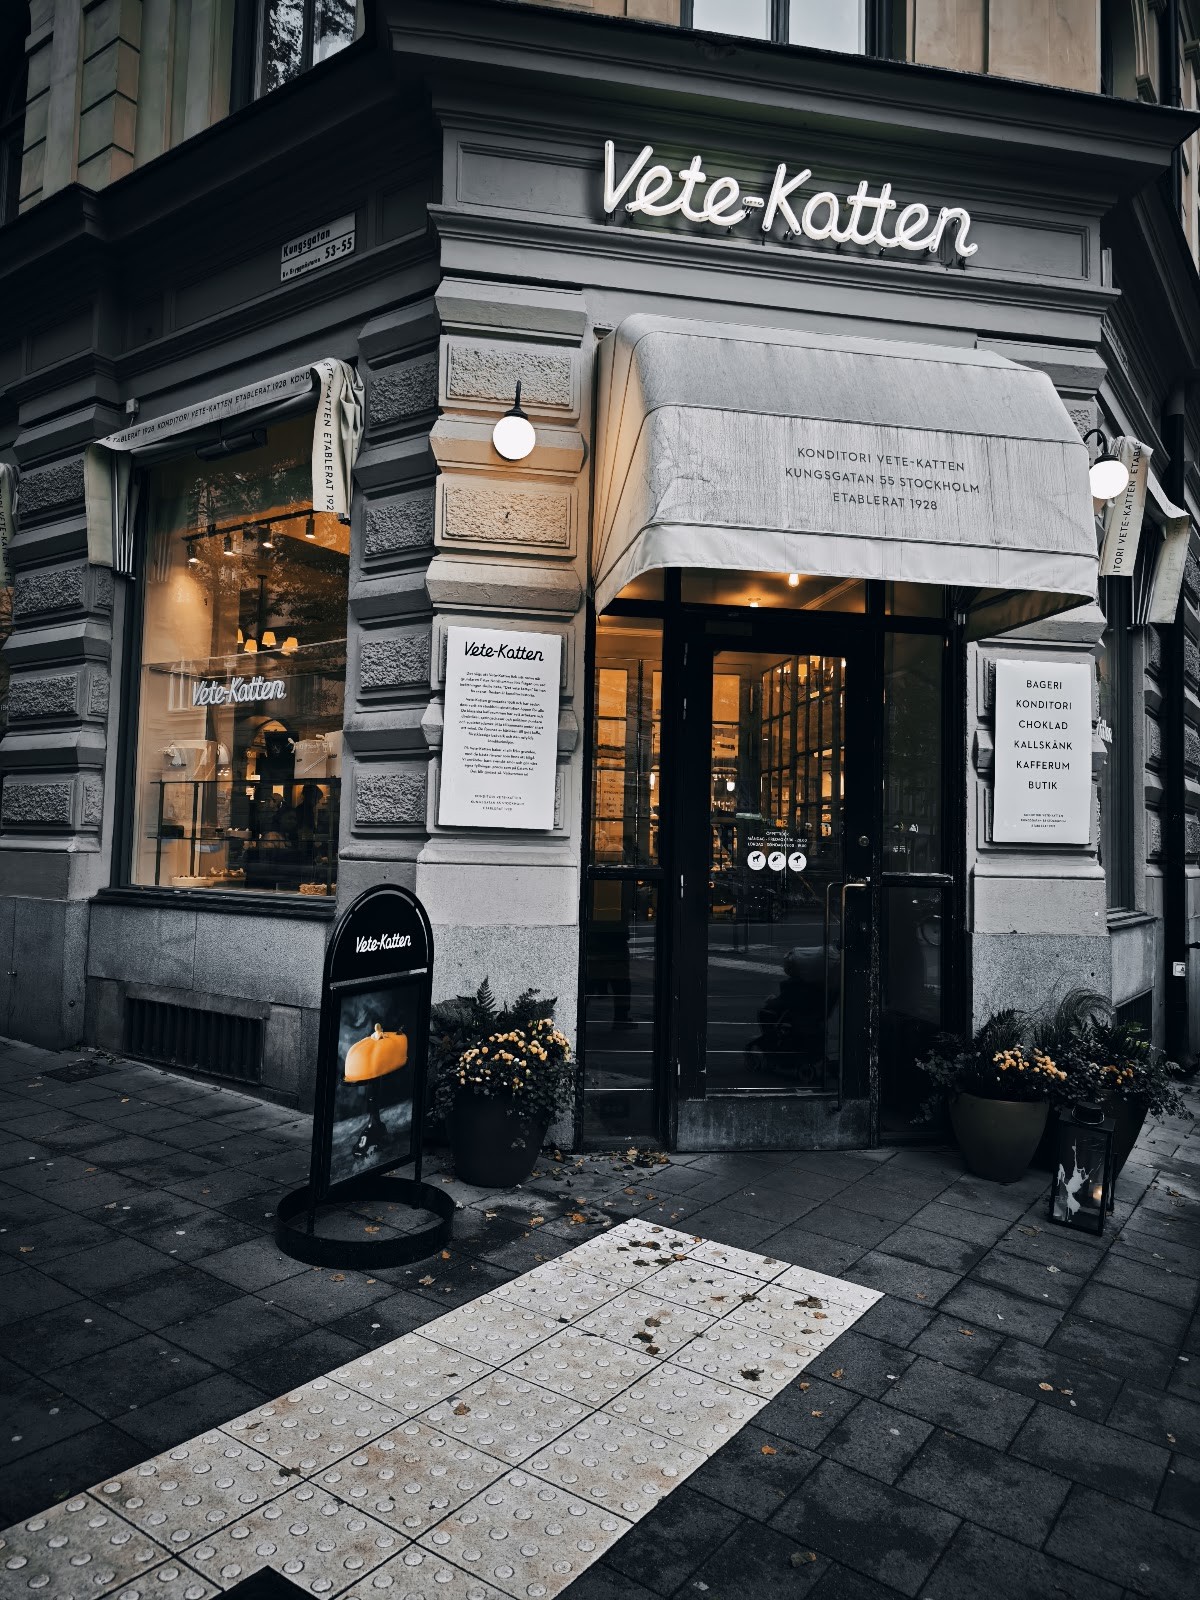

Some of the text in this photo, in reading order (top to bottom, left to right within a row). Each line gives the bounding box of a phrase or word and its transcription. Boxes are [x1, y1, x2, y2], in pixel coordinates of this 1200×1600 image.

[604, 140, 979, 257] Vete-Katten
[283, 229, 331, 258] Kungsgatan
[325, 236, 353, 259] 53-55
[157, 413, 190, 430] KONDITORI
[191, 397, 233, 418] VETE-KATTEN
[235, 384, 271, 404] ETABLERAT
[272, 379, 287, 391] 1928
[323, 432, 335, 491] ETABLERAT
[797, 447, 965, 472] KONDITORI VETE-KATTEN
[785, 467, 980, 494] KUNGSGATAN 55 STOCKHOLM
[833, 492, 938, 511] ETABLERAT 1928
[1118, 479, 1137, 543] VETE-KATTEN
[464, 641, 545, 662] Vete-Katten
[192, 675, 288, 707] Vete-Katten
[1026, 679, 1063, 690] BAGERI
[1016, 699, 1073, 711] KONDITORI
[1018, 719, 1069, 730] CHOKLAD
[1016, 760, 1070, 771] KAFFERUM
[1028, 780, 1058, 790] BUTIK
[356, 932, 412, 954] Vete-Katten
